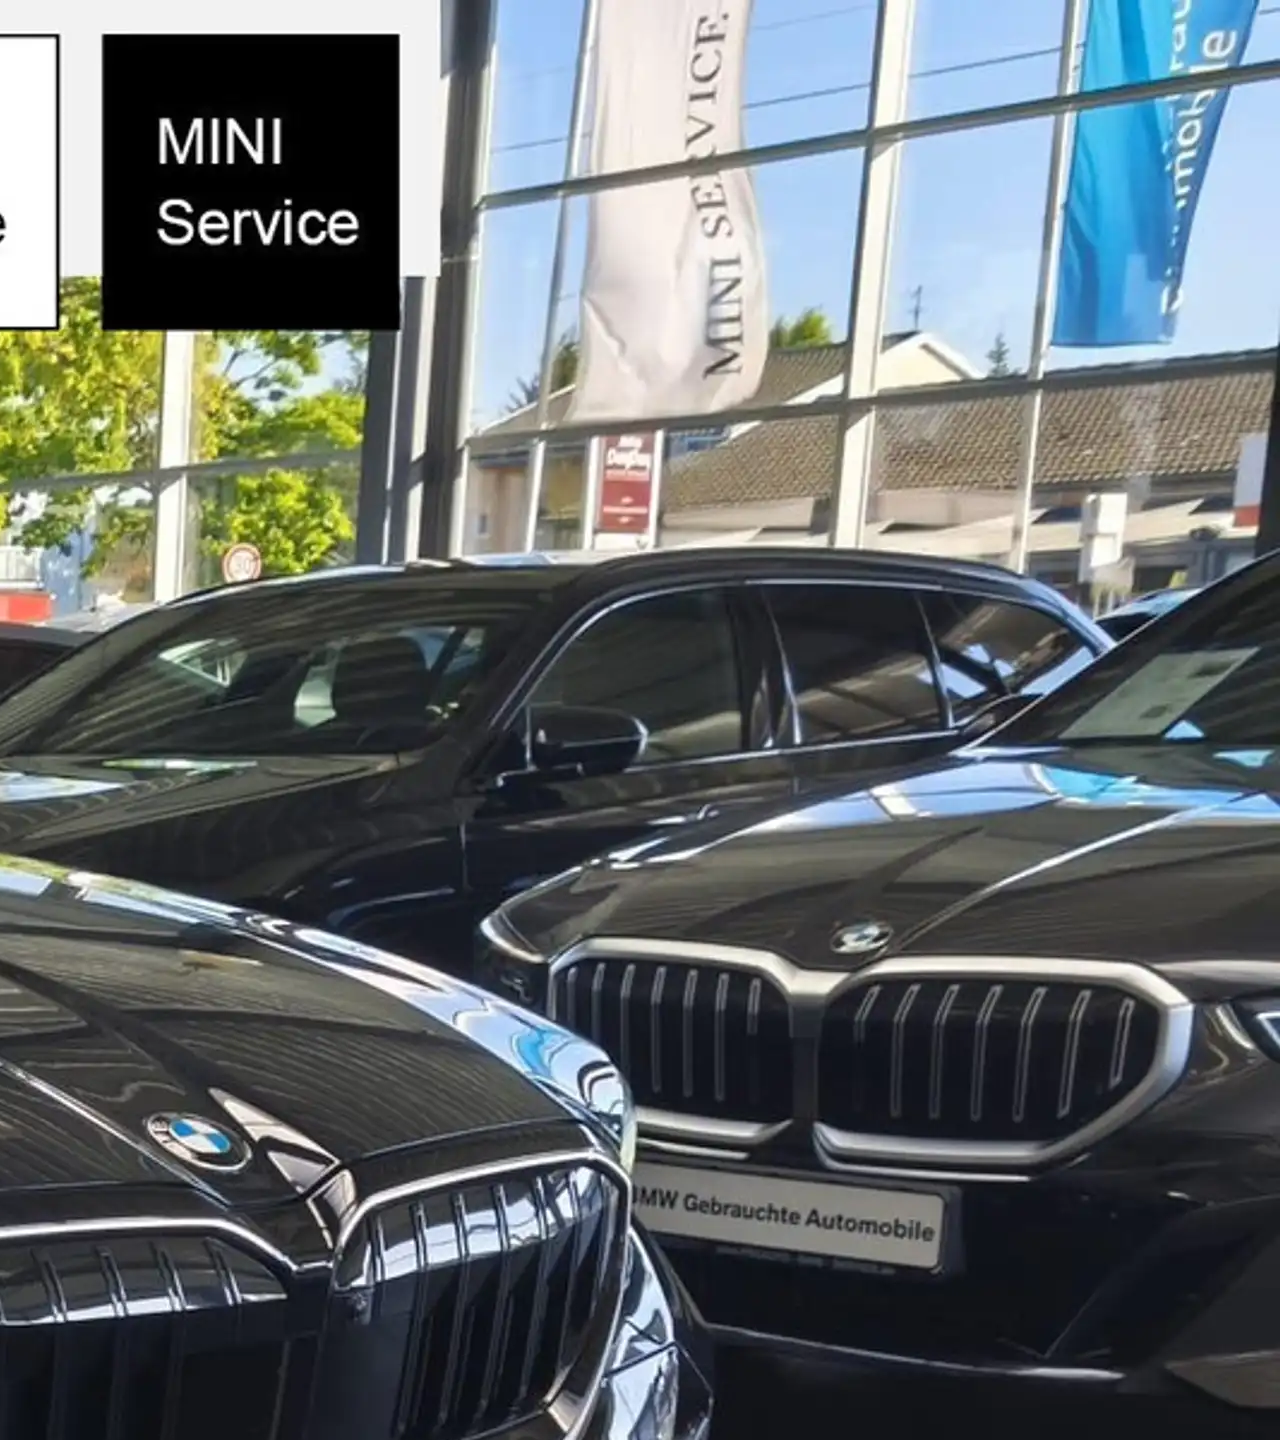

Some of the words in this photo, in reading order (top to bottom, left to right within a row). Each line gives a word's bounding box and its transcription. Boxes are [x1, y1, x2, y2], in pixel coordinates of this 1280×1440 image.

[703, 255, 744, 381] MINI
[683, 1192, 802, 1226] Gebrauchte
[805, 1208, 936, 1242] Automobile
